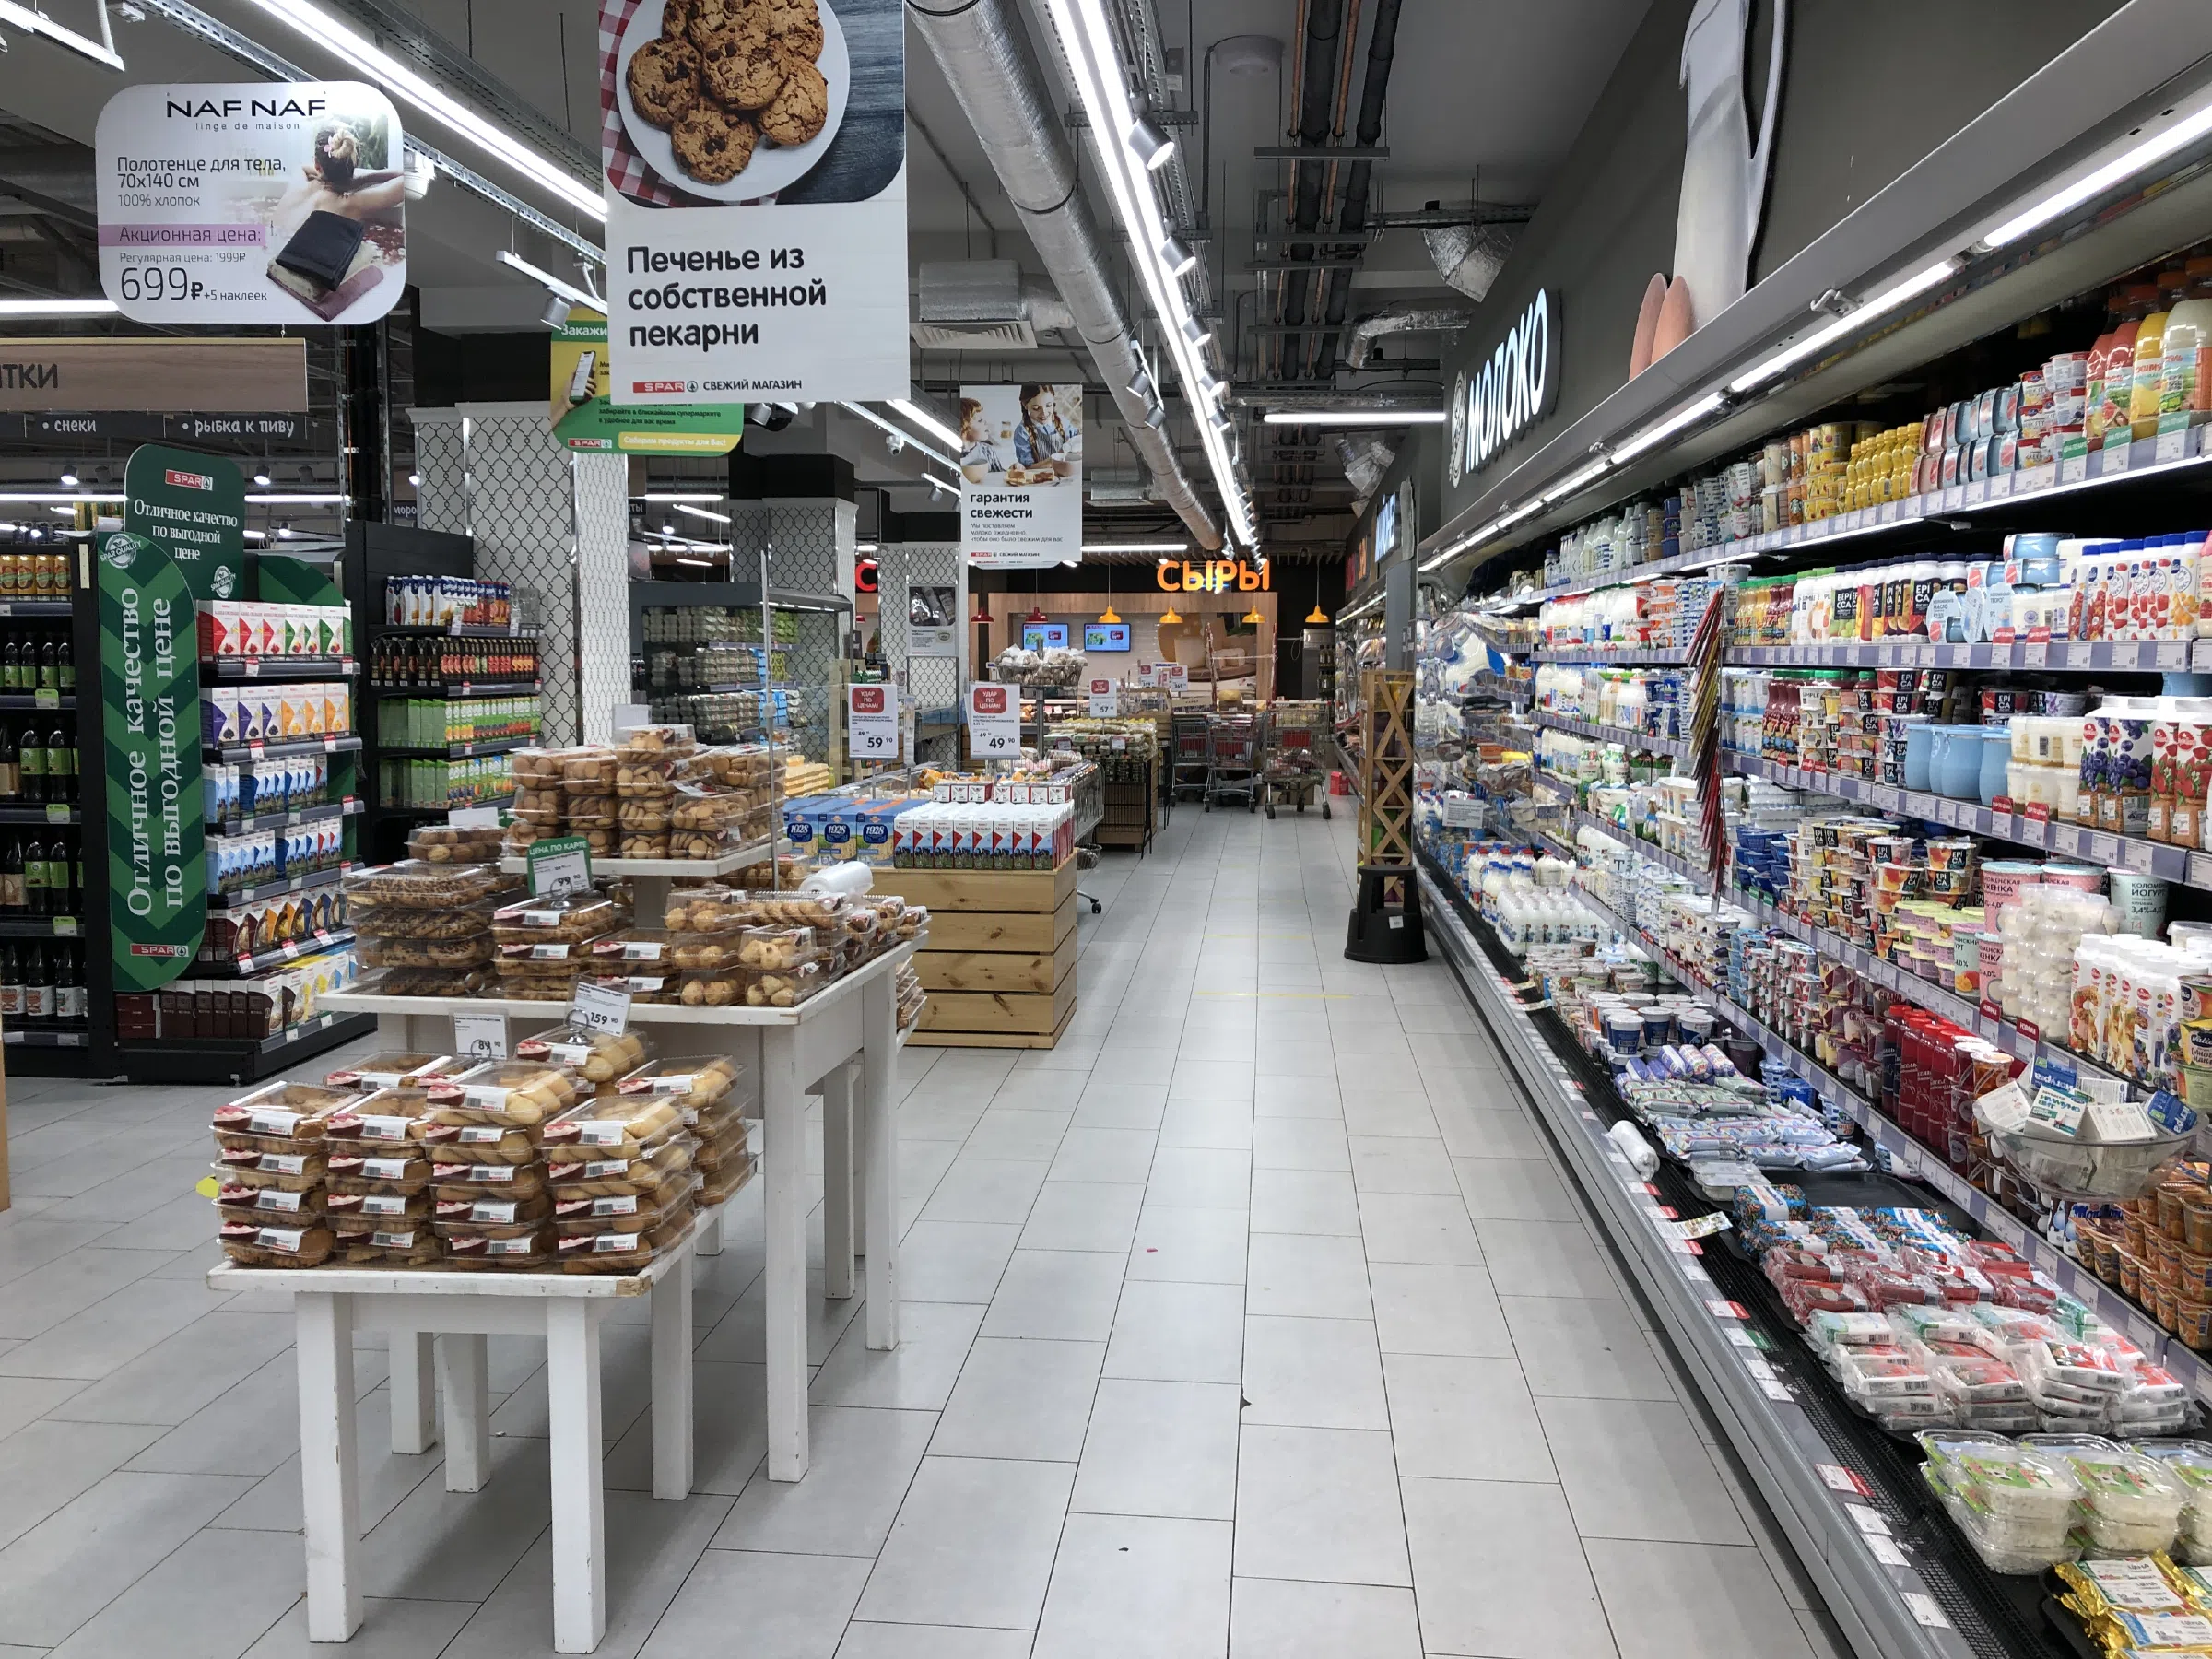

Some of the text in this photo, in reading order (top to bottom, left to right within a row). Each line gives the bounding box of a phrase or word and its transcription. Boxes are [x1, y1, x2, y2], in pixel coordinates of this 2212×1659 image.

[167, 99, 325, 118] NAF NAF
[195, 122, 300, 132] linge de maison
[117, 157, 286, 172] Полотенце для тела,
[178, 177, 200, 188] см
[118, 194, 200, 207] 100% хлопок
[119, 227, 261, 244] Акционная цена:
[119, 253, 182, 264] Регулярная
[184, 253, 213, 264] цена:
[628, 246, 805, 274] Печенье из
[219, 292, 267, 301] наклеек
[628, 278, 827, 310] собственной
[629, 323, 759, 352] пекарни
[0, 364, 58, 388] ТКИ
[1466, 288, 1547, 474] МОЛОКО
[644, 382, 684, 392] SPAR
[703, 379, 802, 391] СВЕЖИЙ МАГАЗИН
[54, 419, 97, 432] снеки
[194, 419, 295, 437] рыбка к пиву
[174, 474, 202, 487] SPAR
[970, 494, 1030, 506] гарантия
[134, 499, 238, 527] Отличное качество
[970, 509, 1033, 518] свежести
[152, 525, 221, 545] по выгодной
[100, 540, 141, 562] SPAR QUALITY
[174, 547, 201, 561] цене
[1157, 559, 1270, 591] СЫРЫ
[1915, 594, 1930, 603] CA
[867, 737, 883, 748] 59
[989, 738, 1005, 748] 49
[121, 587, 152, 916] Отличное качество
[152, 598, 182, 908] по выгодной цене
[790, 824, 809, 834] 1928
[828, 824, 846, 834] 1928
[865, 825, 885, 835] 1928
[529, 846, 549, 855] ЦЕНА
[563, 841, 587, 850] КАРТЕ
[558, 876, 571, 886] 99
[141, 946, 174, 955] SPAR
[590, 1012, 607, 1026] 159
